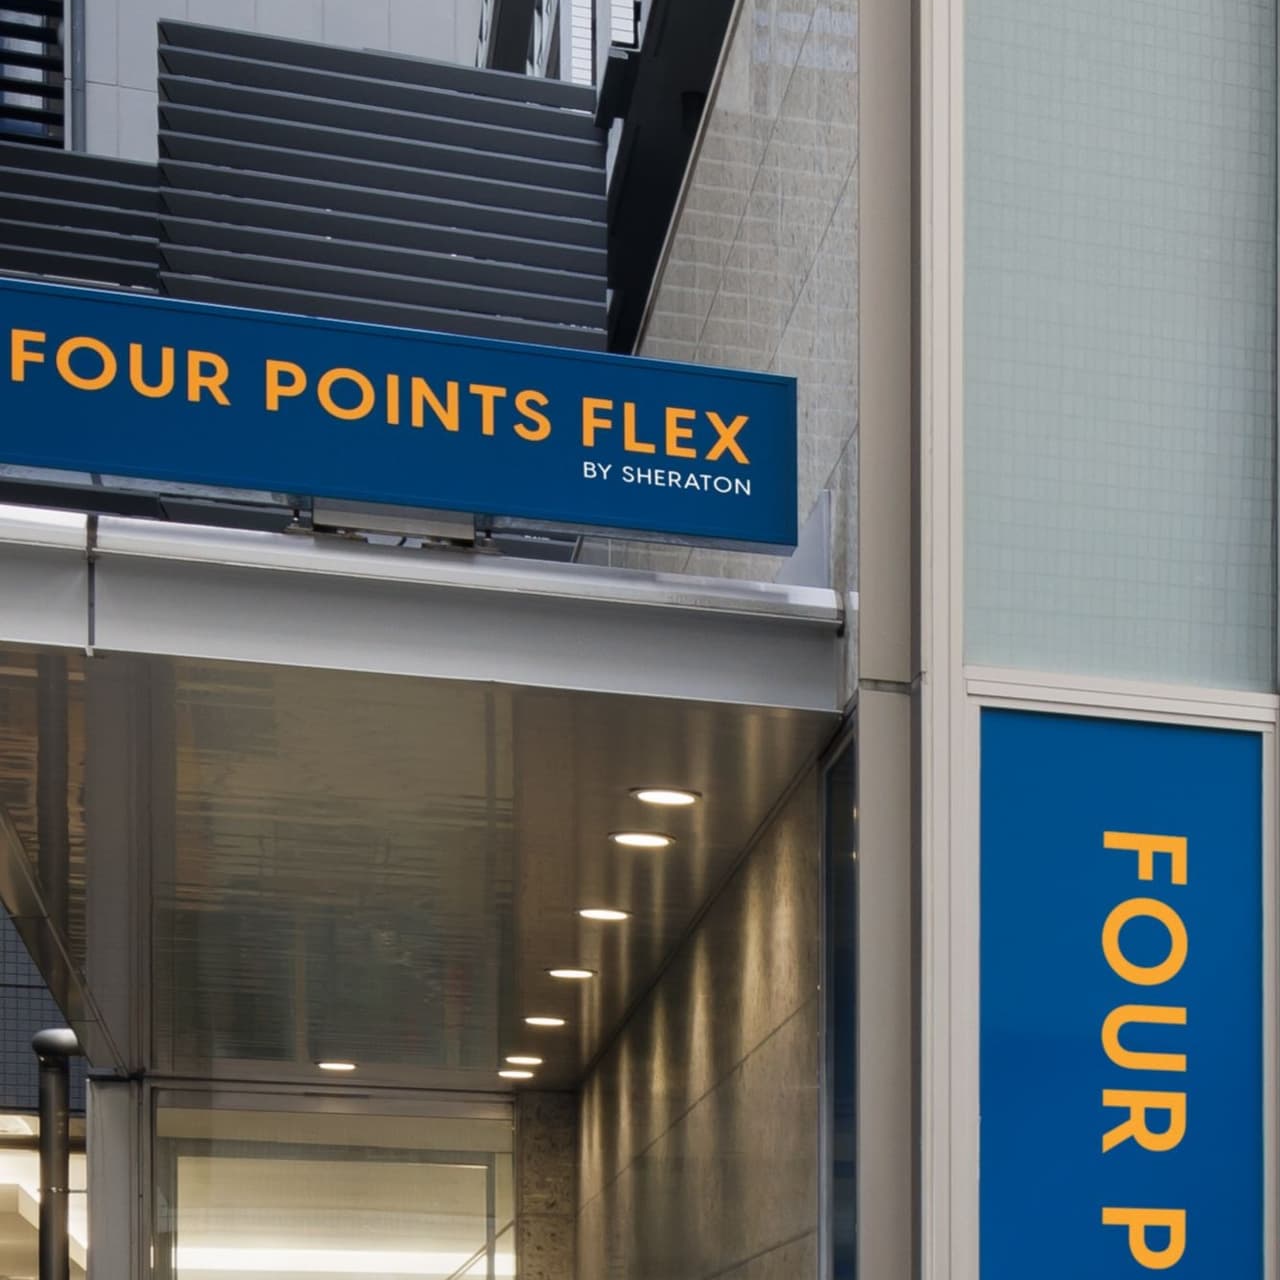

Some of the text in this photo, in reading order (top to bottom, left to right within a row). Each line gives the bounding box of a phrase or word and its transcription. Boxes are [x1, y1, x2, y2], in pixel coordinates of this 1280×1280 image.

[11, 328, 750, 464] FOUR POINTS FLEX
[583, 461, 751, 496] BY SHERATON
[1102, 831, 1188, 1153] FOUR
